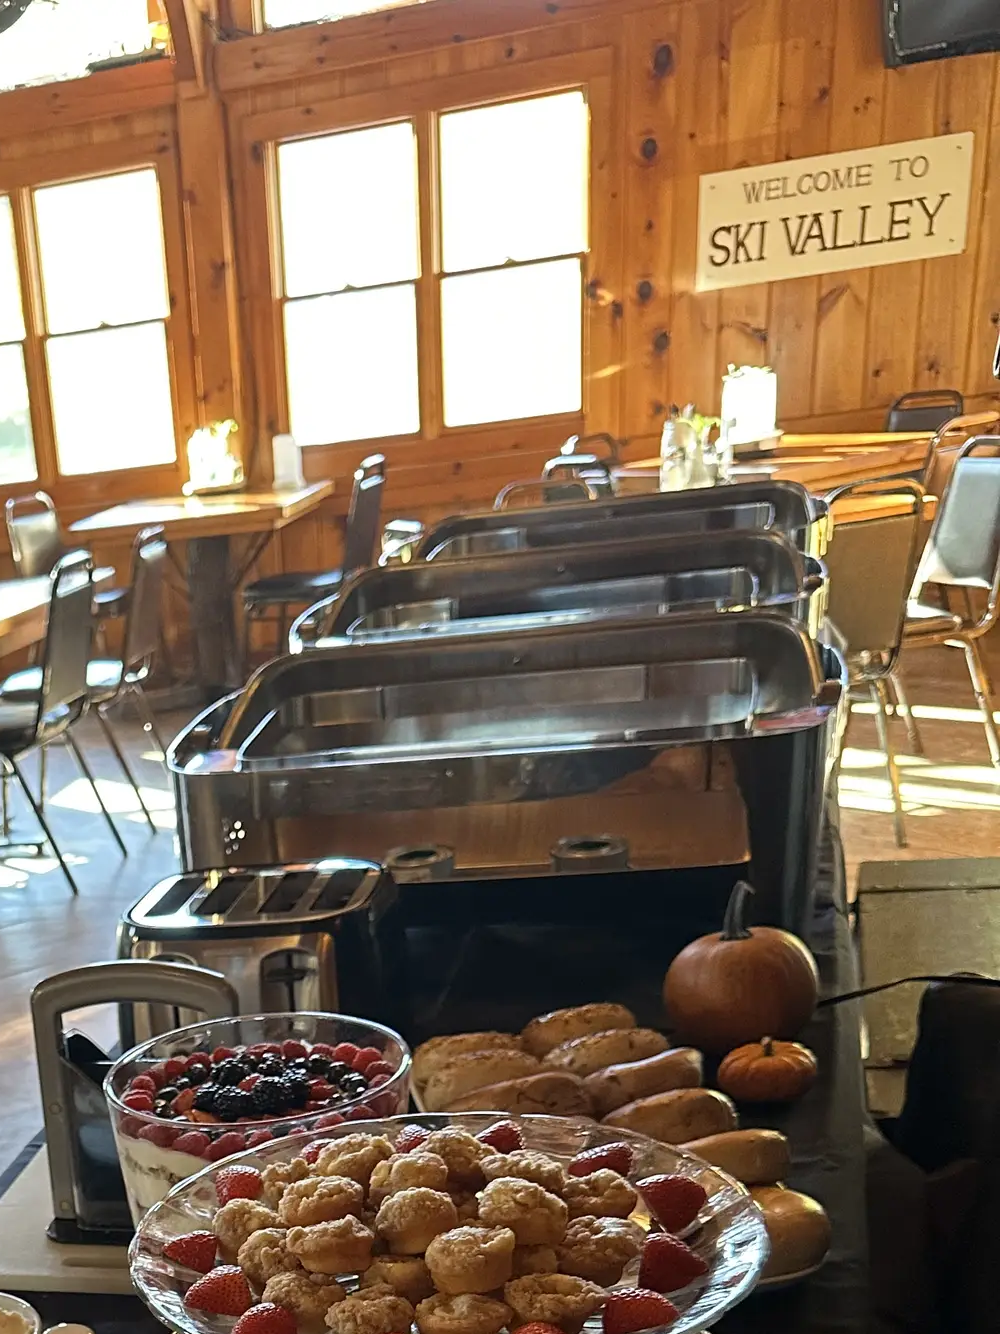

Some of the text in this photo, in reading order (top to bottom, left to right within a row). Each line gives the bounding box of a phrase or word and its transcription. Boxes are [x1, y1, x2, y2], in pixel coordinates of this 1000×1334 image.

[743, 155, 930, 203] WELCOME TO
[709, 193, 951, 267] SKI VALLEY
